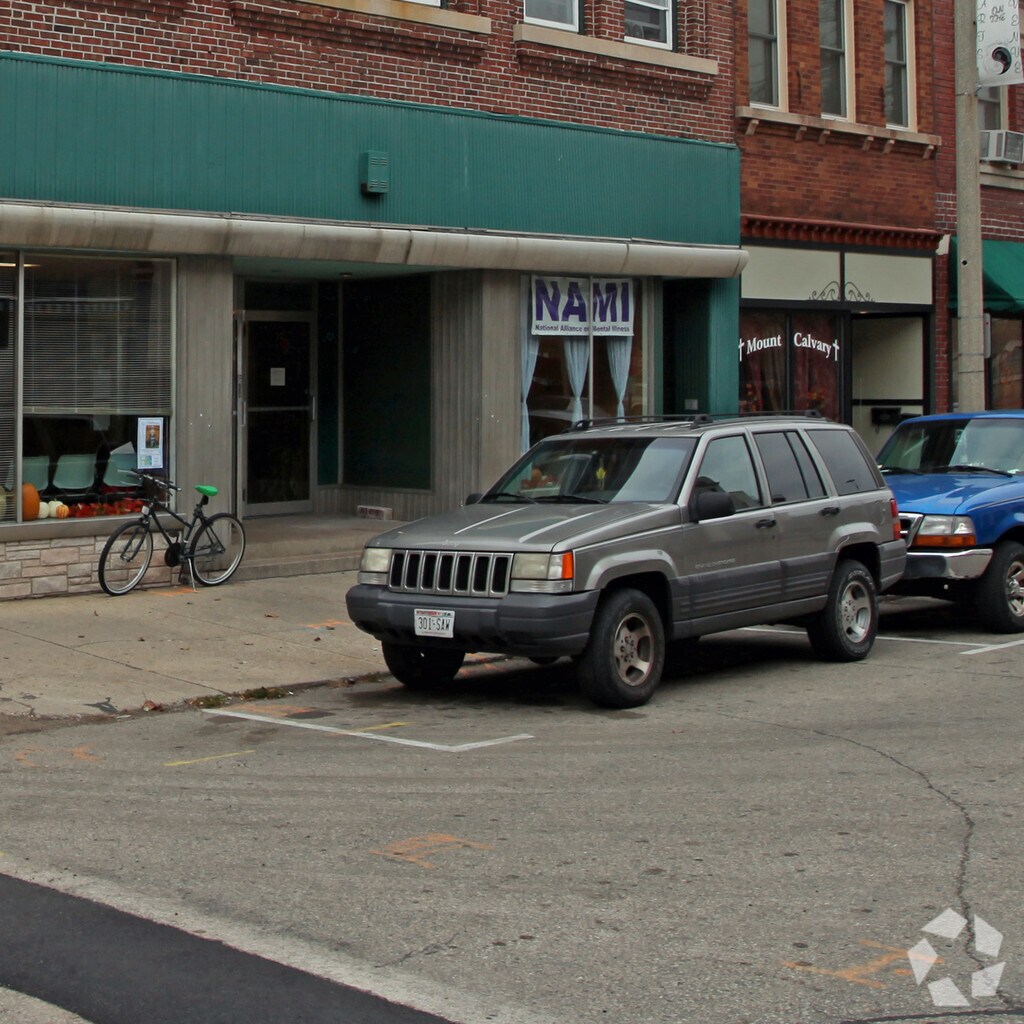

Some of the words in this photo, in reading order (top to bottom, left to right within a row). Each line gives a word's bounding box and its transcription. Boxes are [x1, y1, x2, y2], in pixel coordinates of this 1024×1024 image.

[535, 279, 630, 323] NAMI
[536, 324, 559, 332] National
[746, 335, 782, 355] Mount
[793, 332, 832, 358] Calvary
